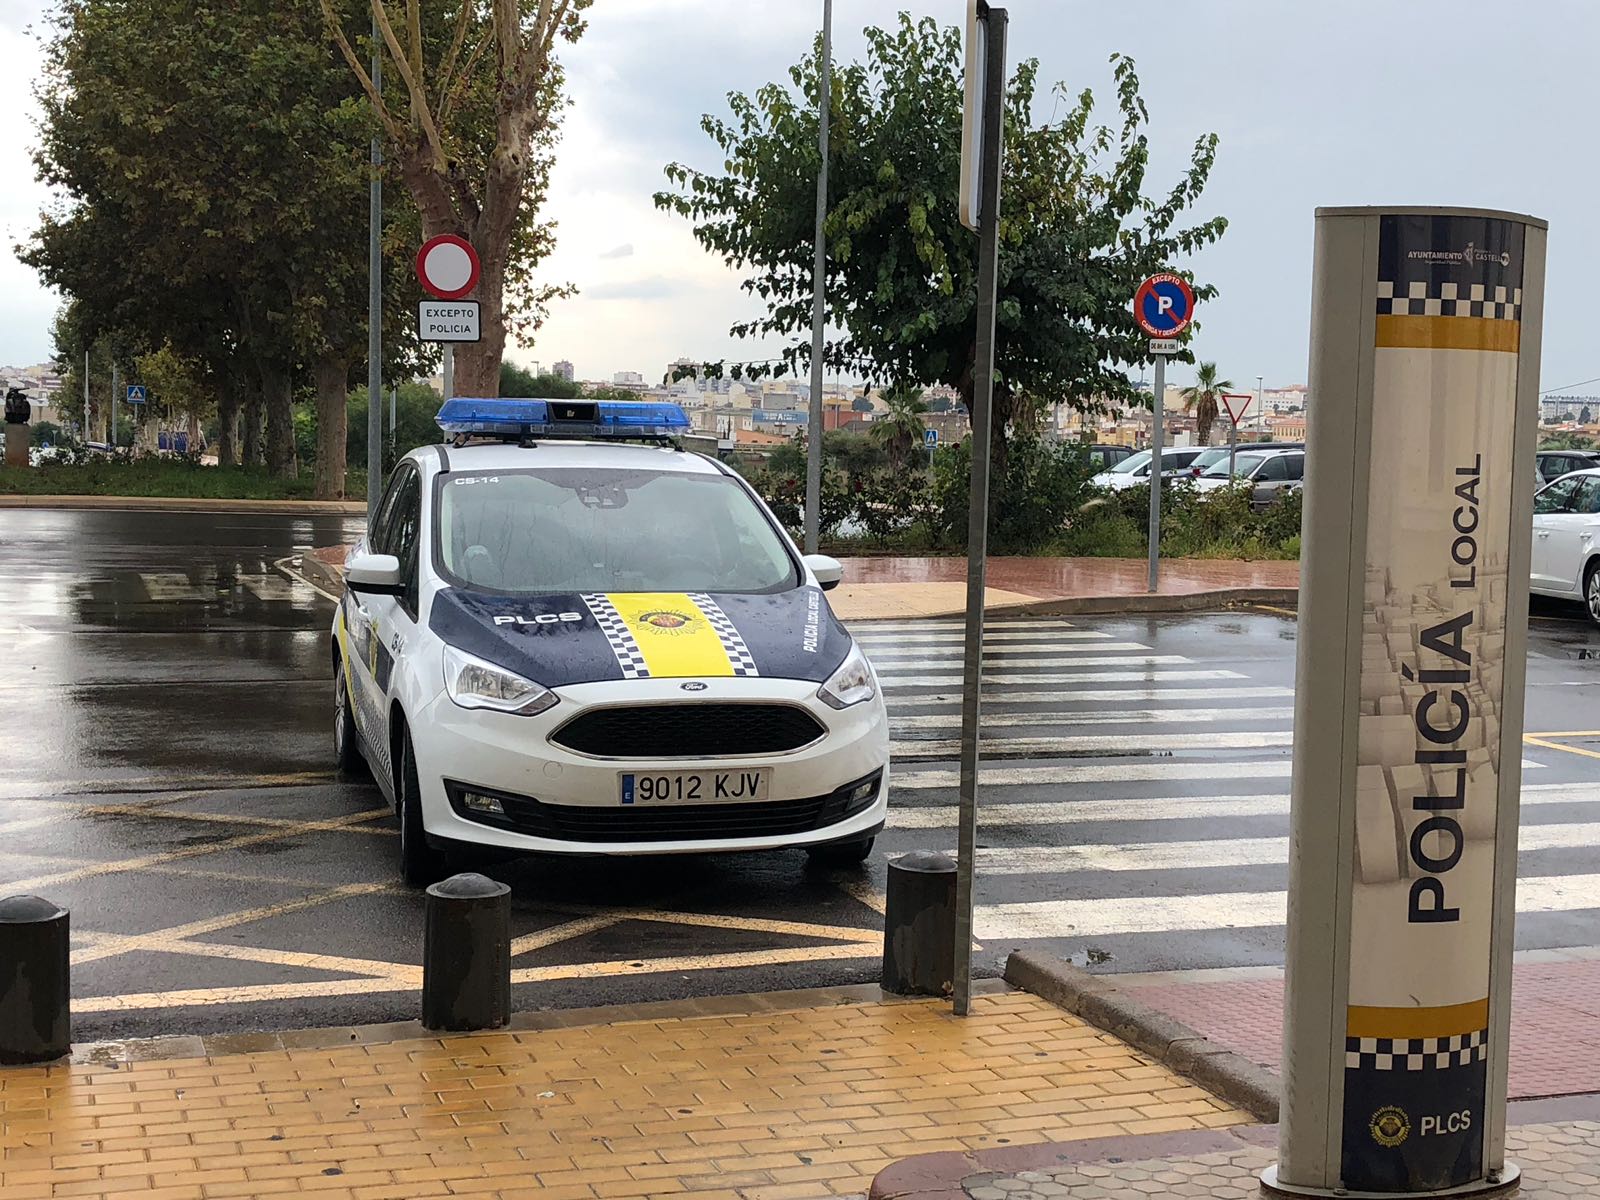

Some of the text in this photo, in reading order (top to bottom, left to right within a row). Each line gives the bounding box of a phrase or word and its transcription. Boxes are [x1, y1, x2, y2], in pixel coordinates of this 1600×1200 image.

[1408, 251, 1463, 260] AYUNTAMIENTO
[1152, 275, 1181, 285] EXCEPTO
[1158, 296, 1173, 315] P
[426, 309, 474, 318] EXCEPTO
[430, 324, 471, 333] POLICIA
[455, 477, 500, 485] CS-14
[493, 612, 583, 626] PLCS
[1401, 453, 1482, 924] POLICÍA LOCAL
[640, 773, 760, 800] 9012 KJV
[1421, 1109, 1471, 1136] PLCS
